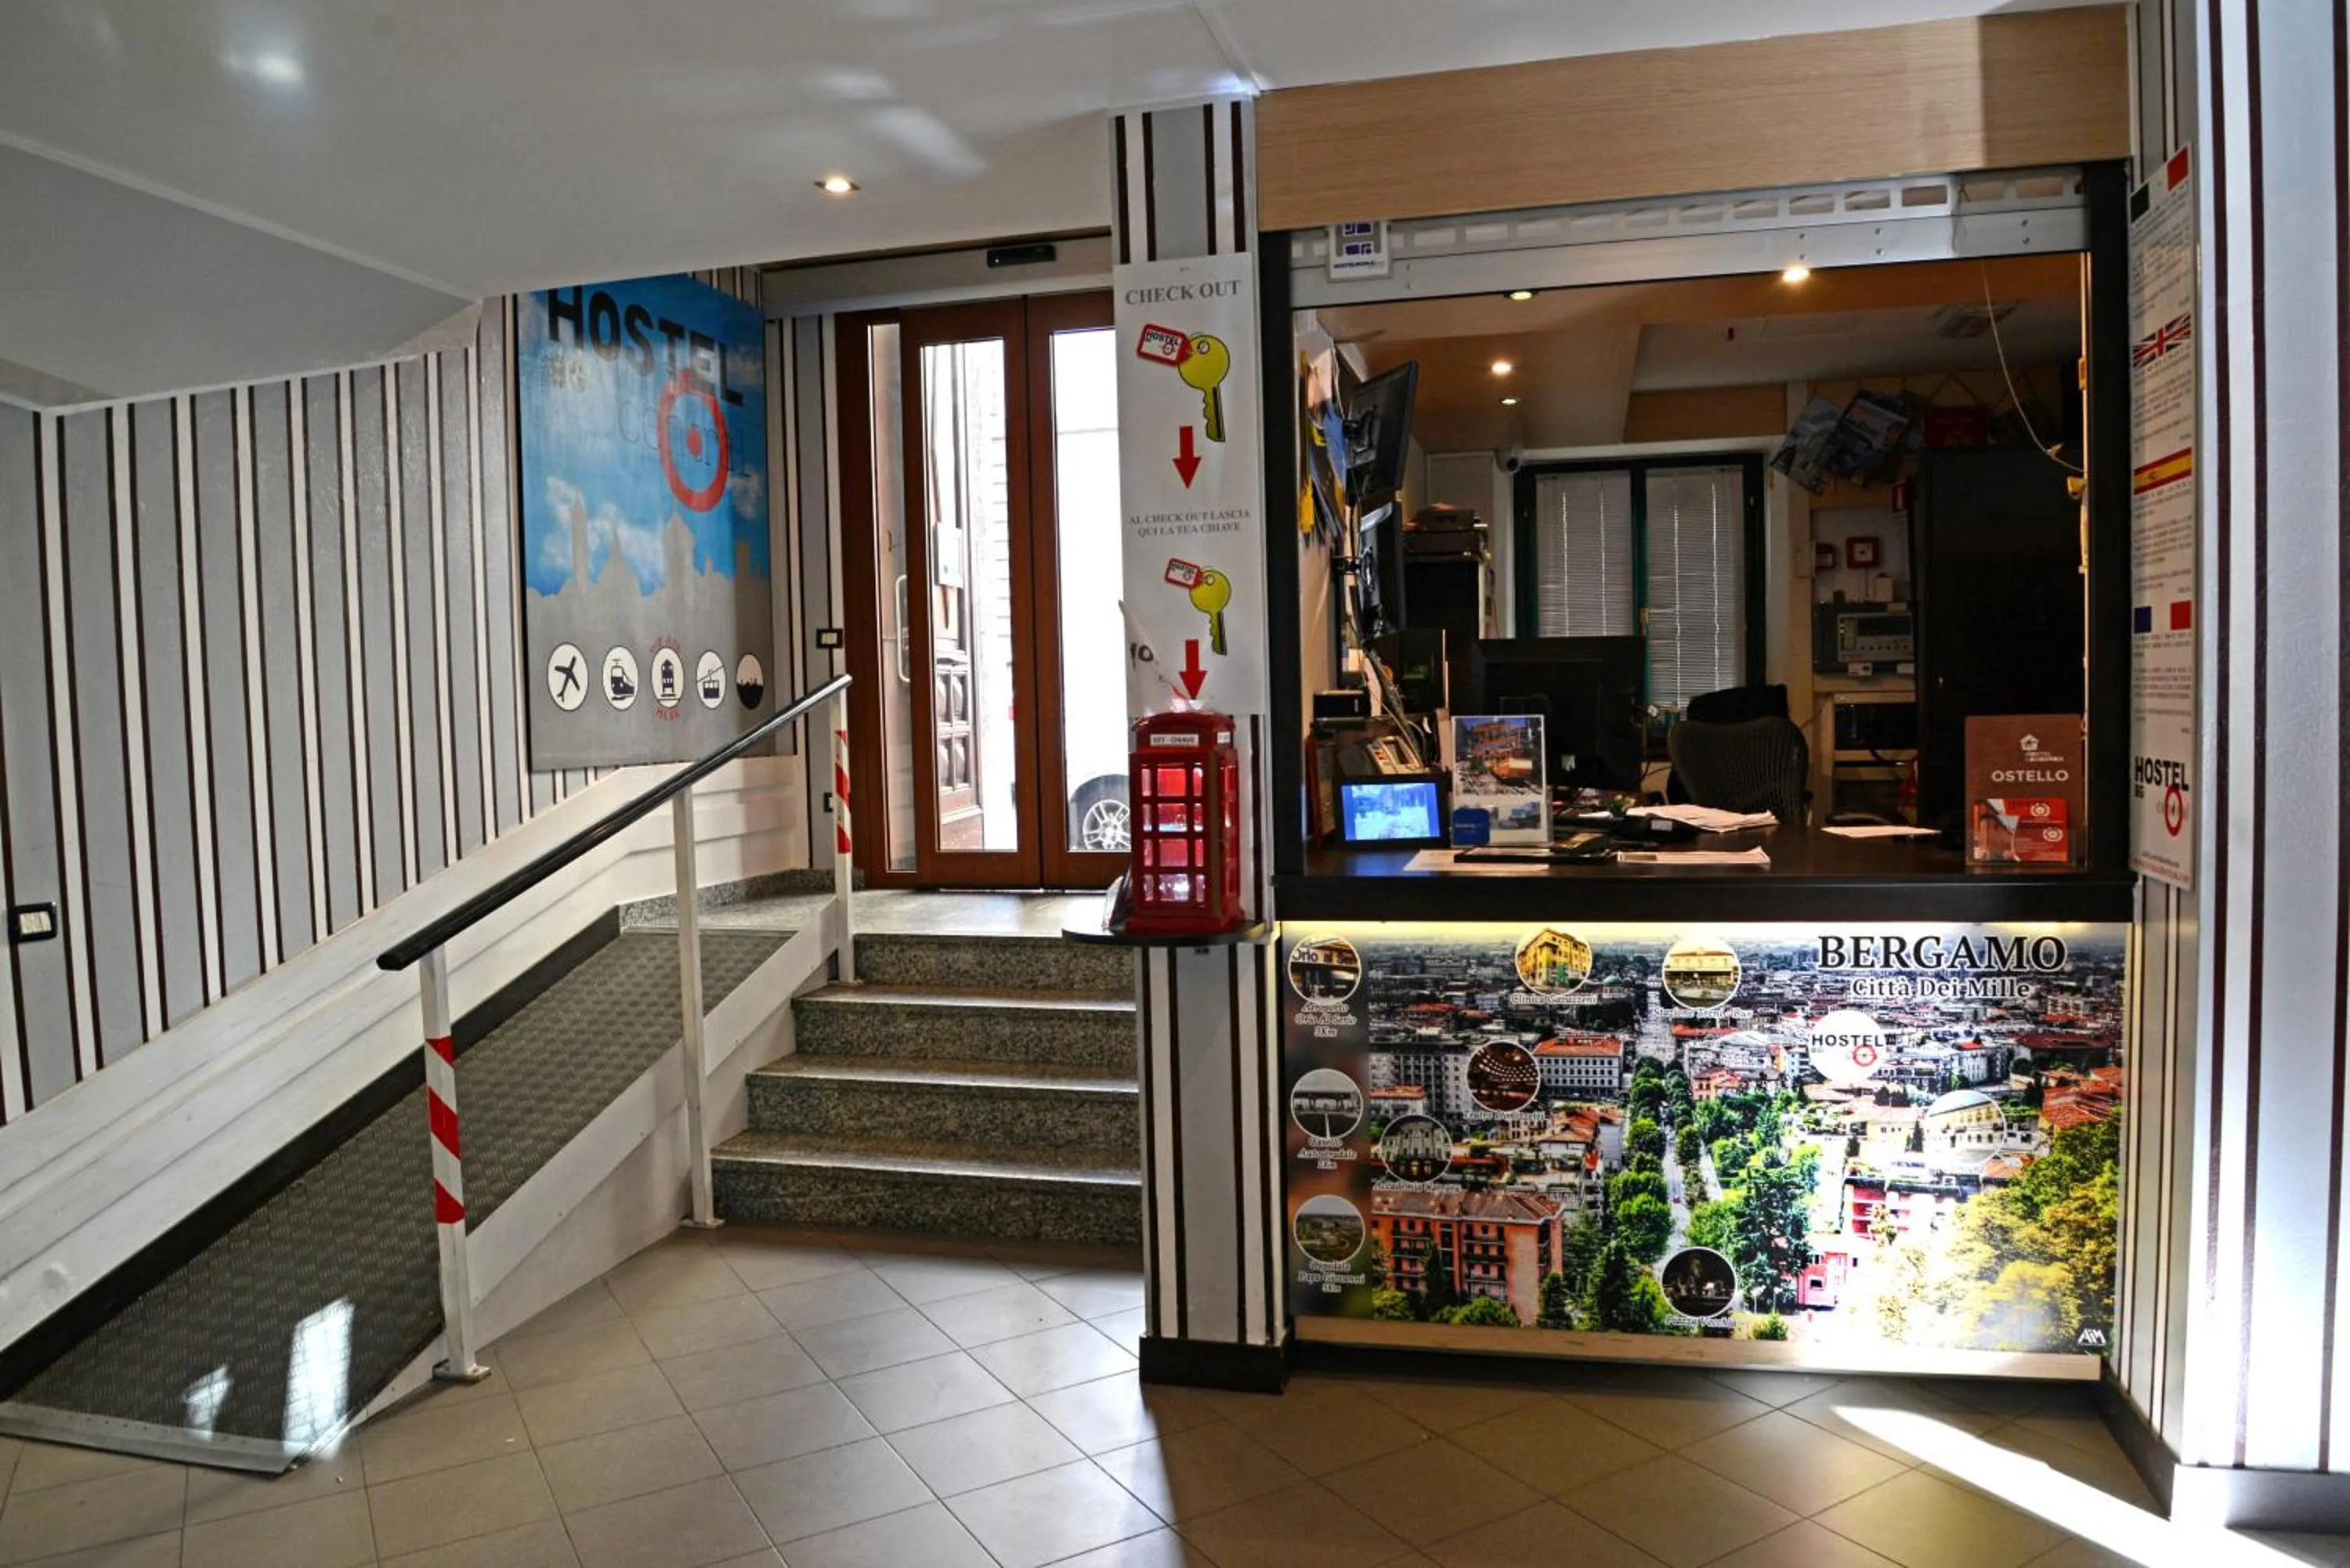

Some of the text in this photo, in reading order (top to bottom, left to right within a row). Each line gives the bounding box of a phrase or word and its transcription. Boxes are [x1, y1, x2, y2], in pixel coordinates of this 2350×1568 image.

[1125, 280, 1242, 305] CHECK OUT
[549, 285, 743, 406] HOSTEL
[1144, 511, 1184, 524] CHECK
[1185, 510, 1209, 521] OUT
[1210, 508, 1251, 520] LASCIA
[1137, 522, 1242, 538] QUI LA TUA CHIAVE
[1991, 770, 2069, 782] OSTELLO
[2134, 755, 2189, 792] HOSTEL
[1817, 935, 2068, 971] BERGAMO
[1852, 977, 2030, 998] Città Dei Mille
[1812, 1035, 1884, 1047] HOSTEL
